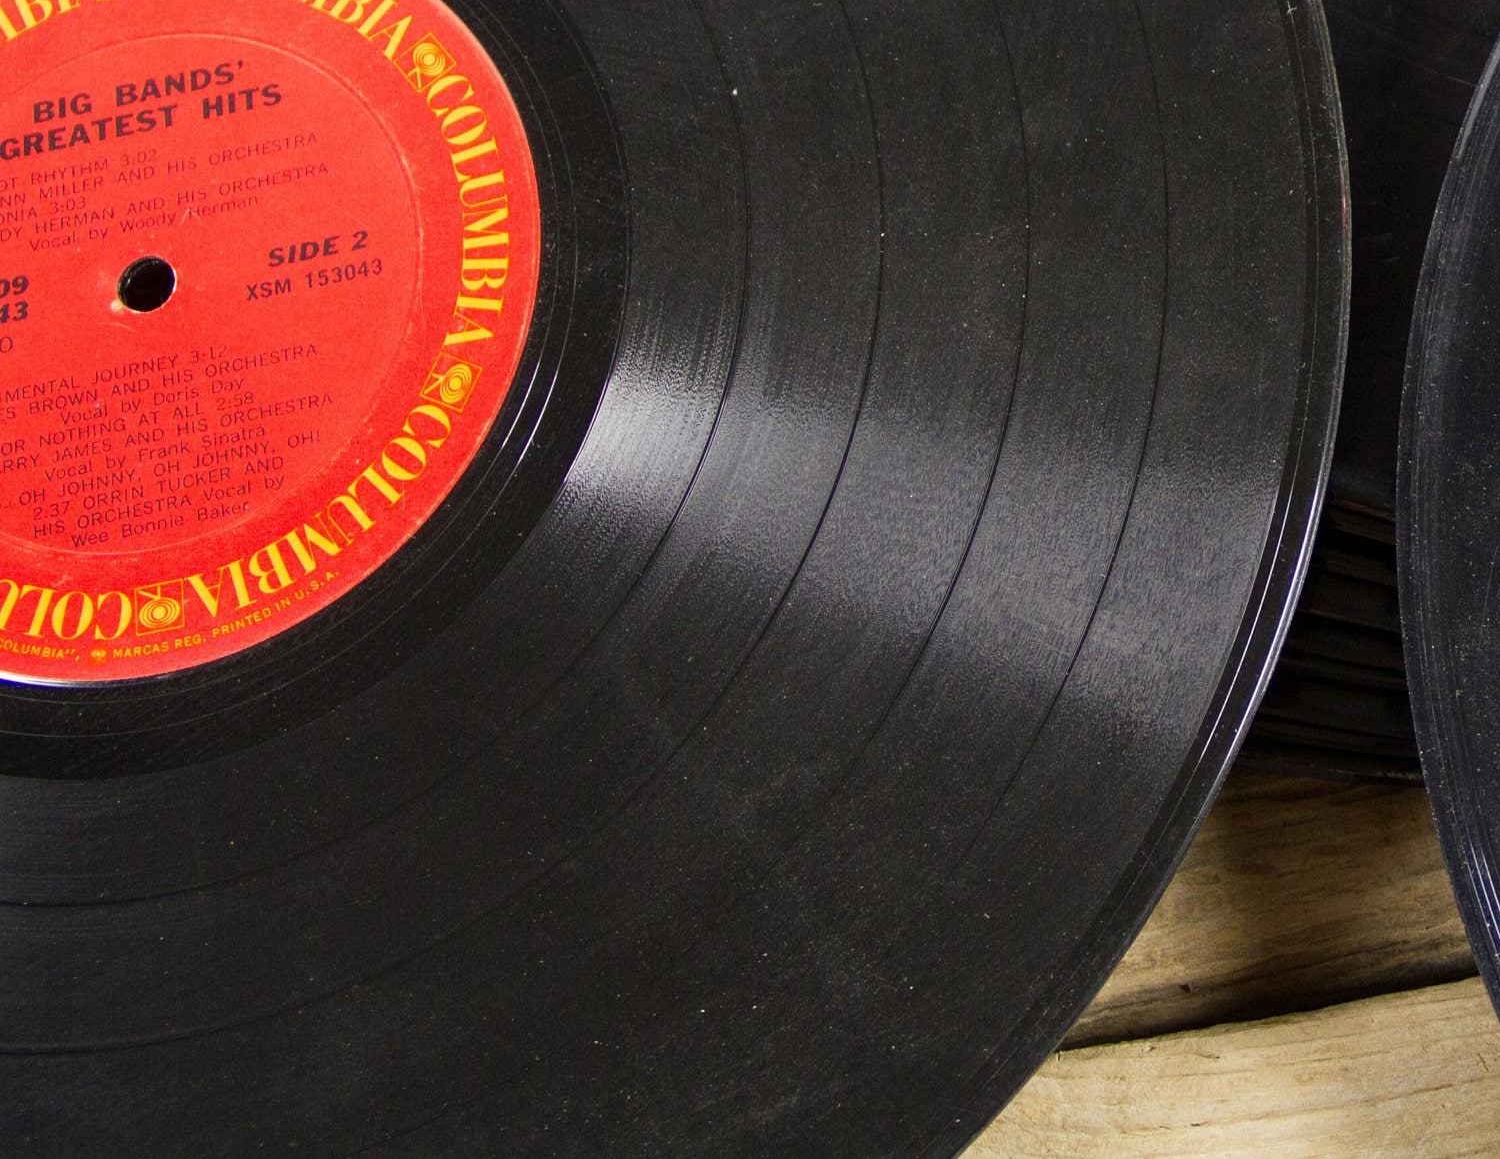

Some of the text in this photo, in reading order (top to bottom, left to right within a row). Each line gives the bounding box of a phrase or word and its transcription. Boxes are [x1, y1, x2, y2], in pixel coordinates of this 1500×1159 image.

[0, 84, 281, 161] GREATEST HITS
[33, 59, 243, 124] BIG BANDS'
[39, 175, 103, 202] MILLER
[117, 165, 154, 184] AND
[167, 156, 197, 175] HIS
[208, 132, 317, 165] ORCHESTRA
[426, 74, 510, 346] COLUMBIA
[246, 257, 384, 302] XSM 153043
[268, 230, 369, 268] SIDE 2
[29, 343, 317, 414] BROWN AND HIS ORCHESTRA
[91, 353, 178, 385] JOURNEY
[189, 343, 227, 364] 3:12
[0, 390, 254, 457] OR NOTHING AT ALL 2:58
[59, 374, 244, 426] Vocal by Doris Day
[18, 429, 320, 506] OH JOHNNY, OH JOHNNY, OH!
[44, 423, 265, 483] Vocal by Frank Sinatra
[32, 455, 283, 520] 2:37 ORRIN TUCKER AND
[33, 474, 284, 539] HIS ORCHESTRA Vocal by
[184, 404, 451, 618] COLUMBIA
[70, 500, 249, 548] Wee Bonnie Baker
[112, 639, 170, 660] MARCAS
[174, 630, 207, 650] REG.
[212, 606, 272, 638] PRINTED
[275, 597, 292, 612] IN
